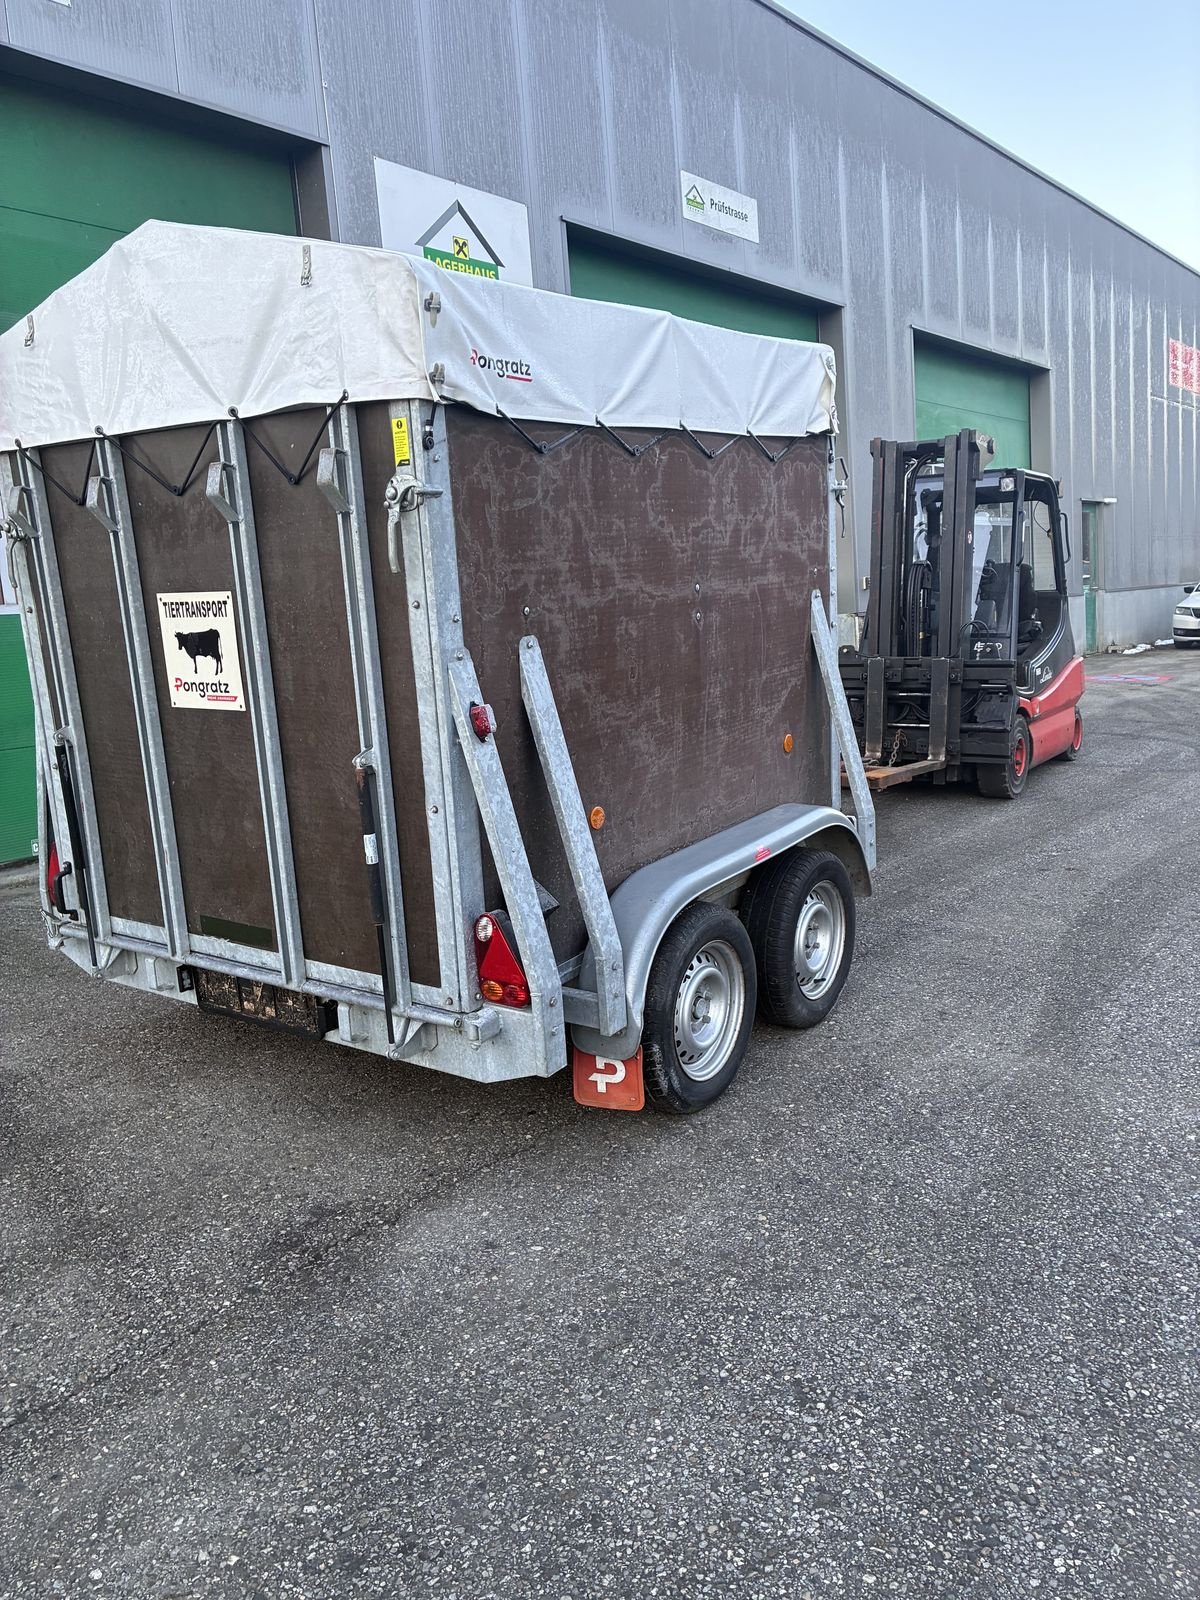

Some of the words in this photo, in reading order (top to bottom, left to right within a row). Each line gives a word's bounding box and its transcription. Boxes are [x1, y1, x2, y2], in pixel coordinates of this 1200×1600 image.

[709, 198, 749, 222] Prüfstrasse
[470, 349, 531, 378] Pongratz
[163, 600, 228, 618] TIERTRANSPORT
[174, 677, 230, 698] Pongratz
